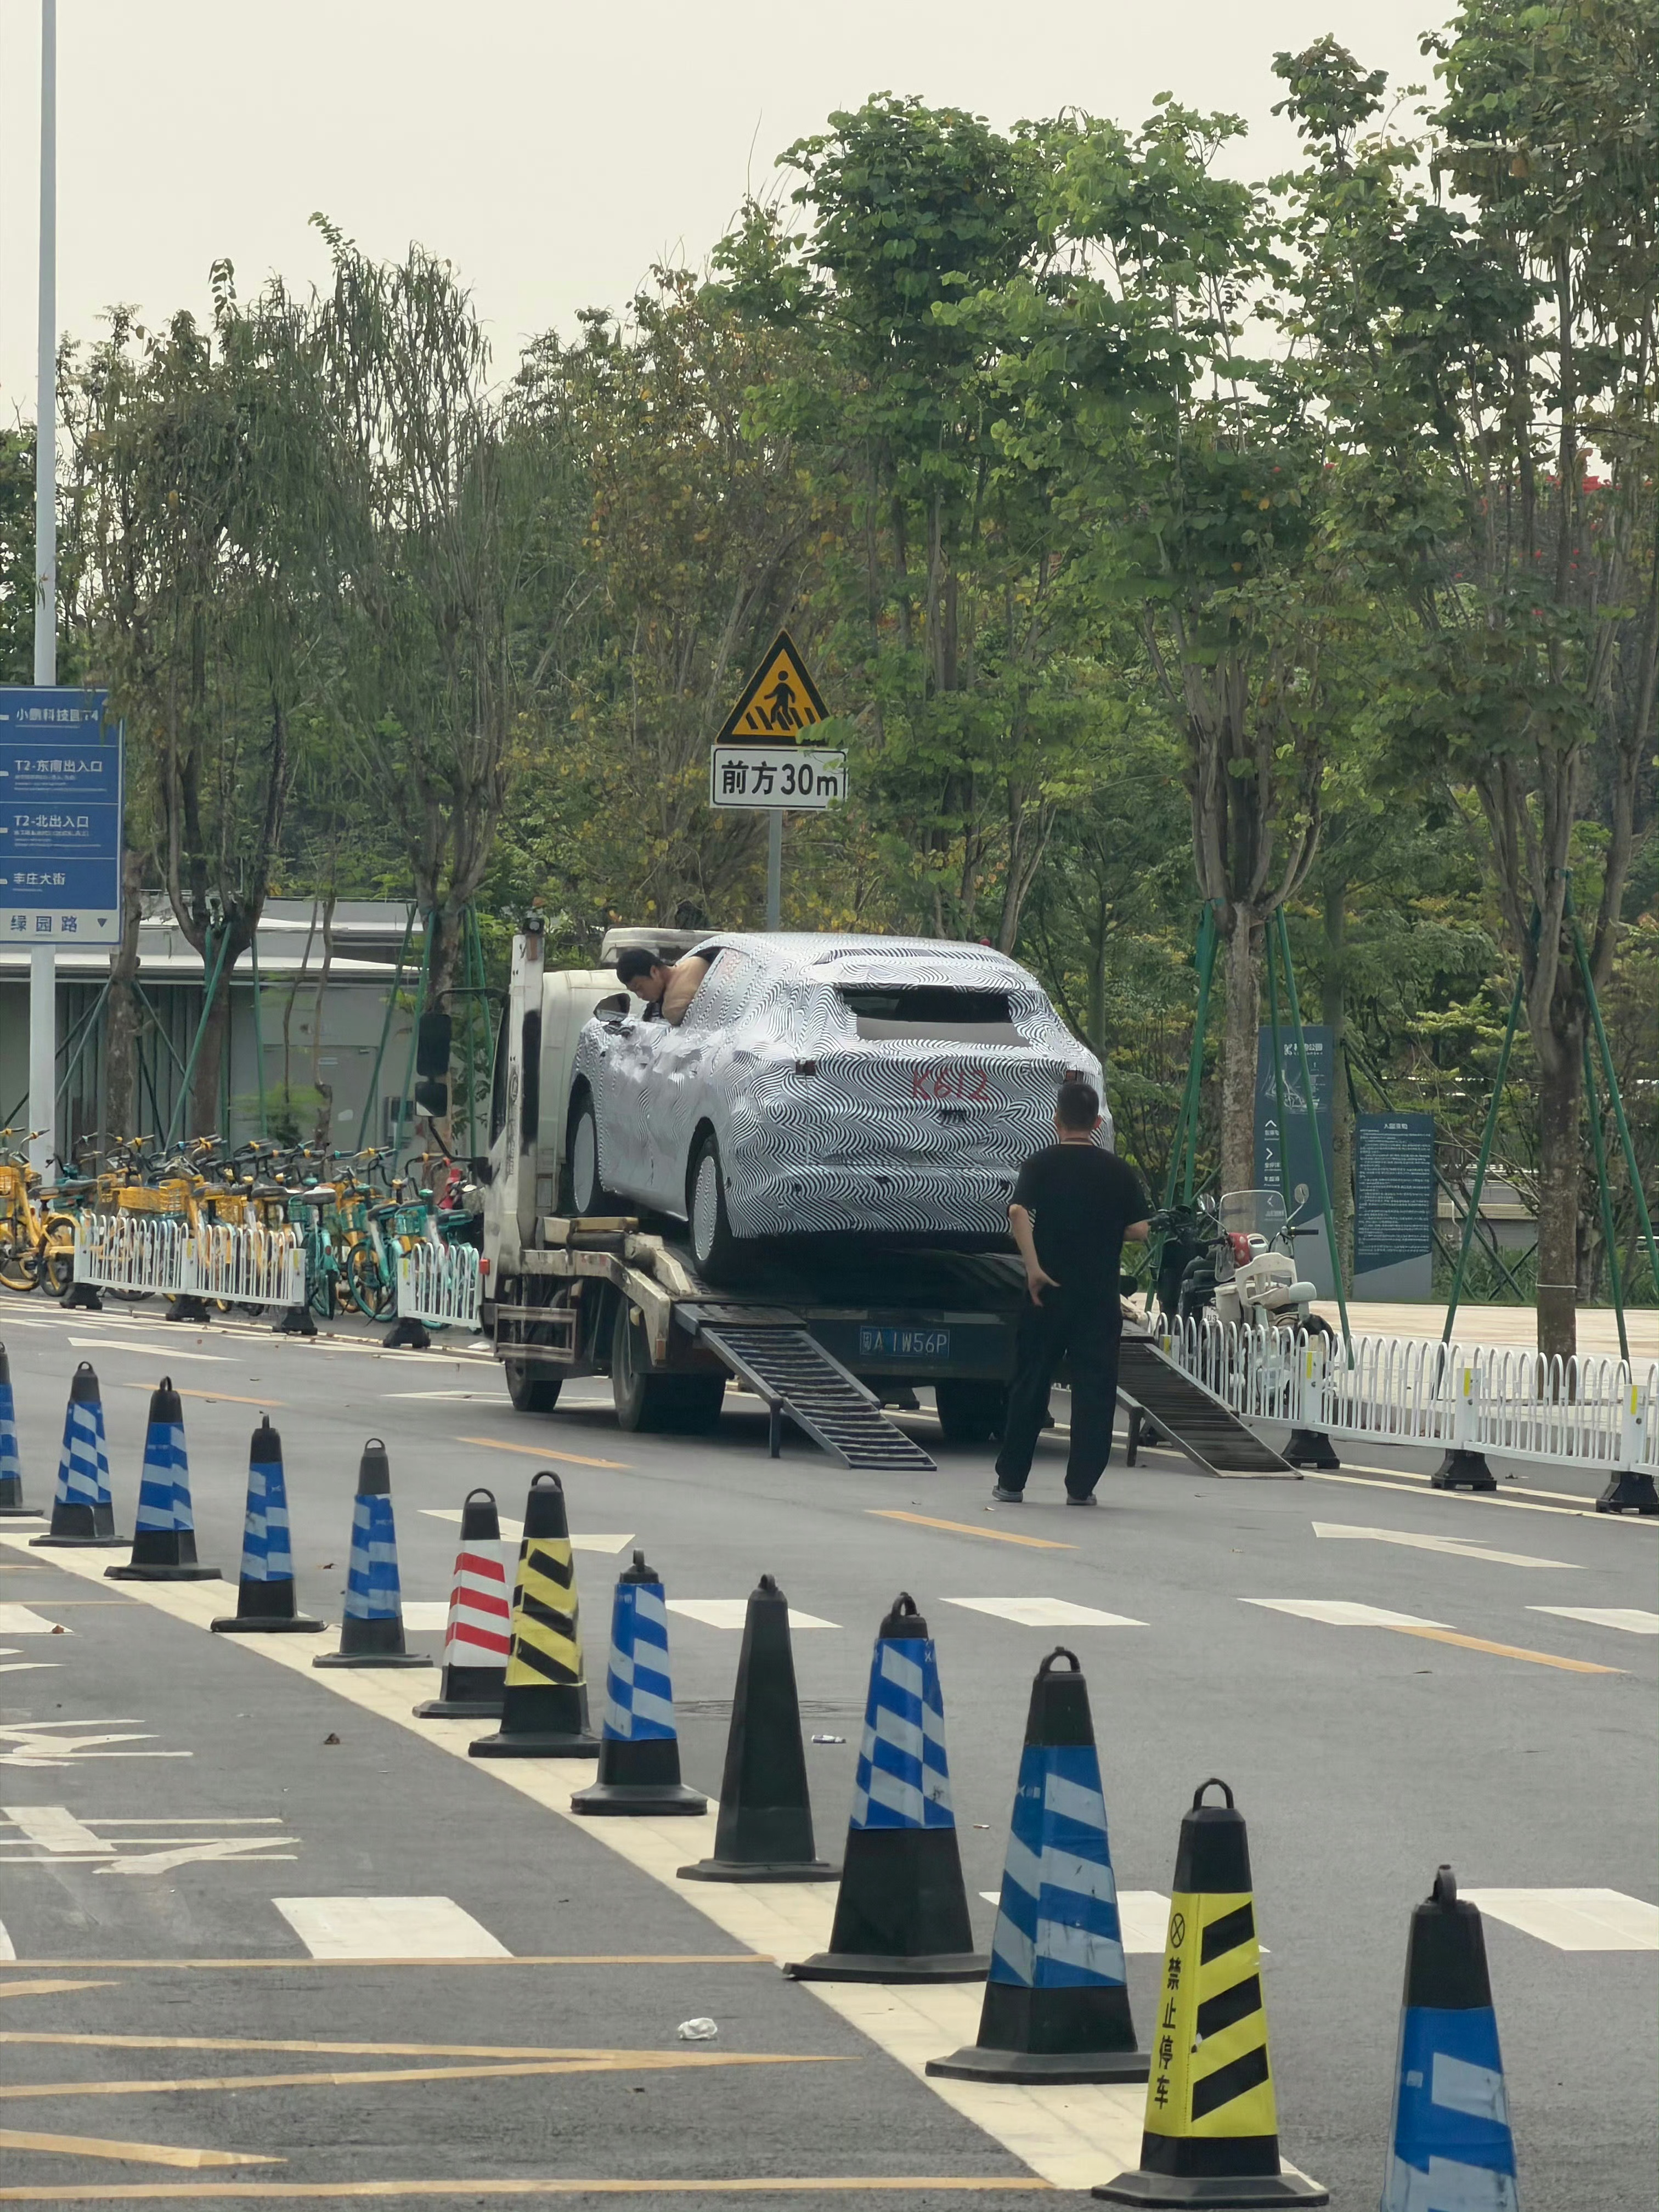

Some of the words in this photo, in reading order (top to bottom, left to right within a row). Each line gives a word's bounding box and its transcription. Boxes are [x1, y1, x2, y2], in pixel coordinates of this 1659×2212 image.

[721, 760, 838, 796] 前方30m
[14, 815, 89, 828] T2-北出入口
[10, 915, 78, 933] 绿园路
[912, 1069, 991, 1102] K612
[1154, 1956, 1182, 2110] 禁止停车
